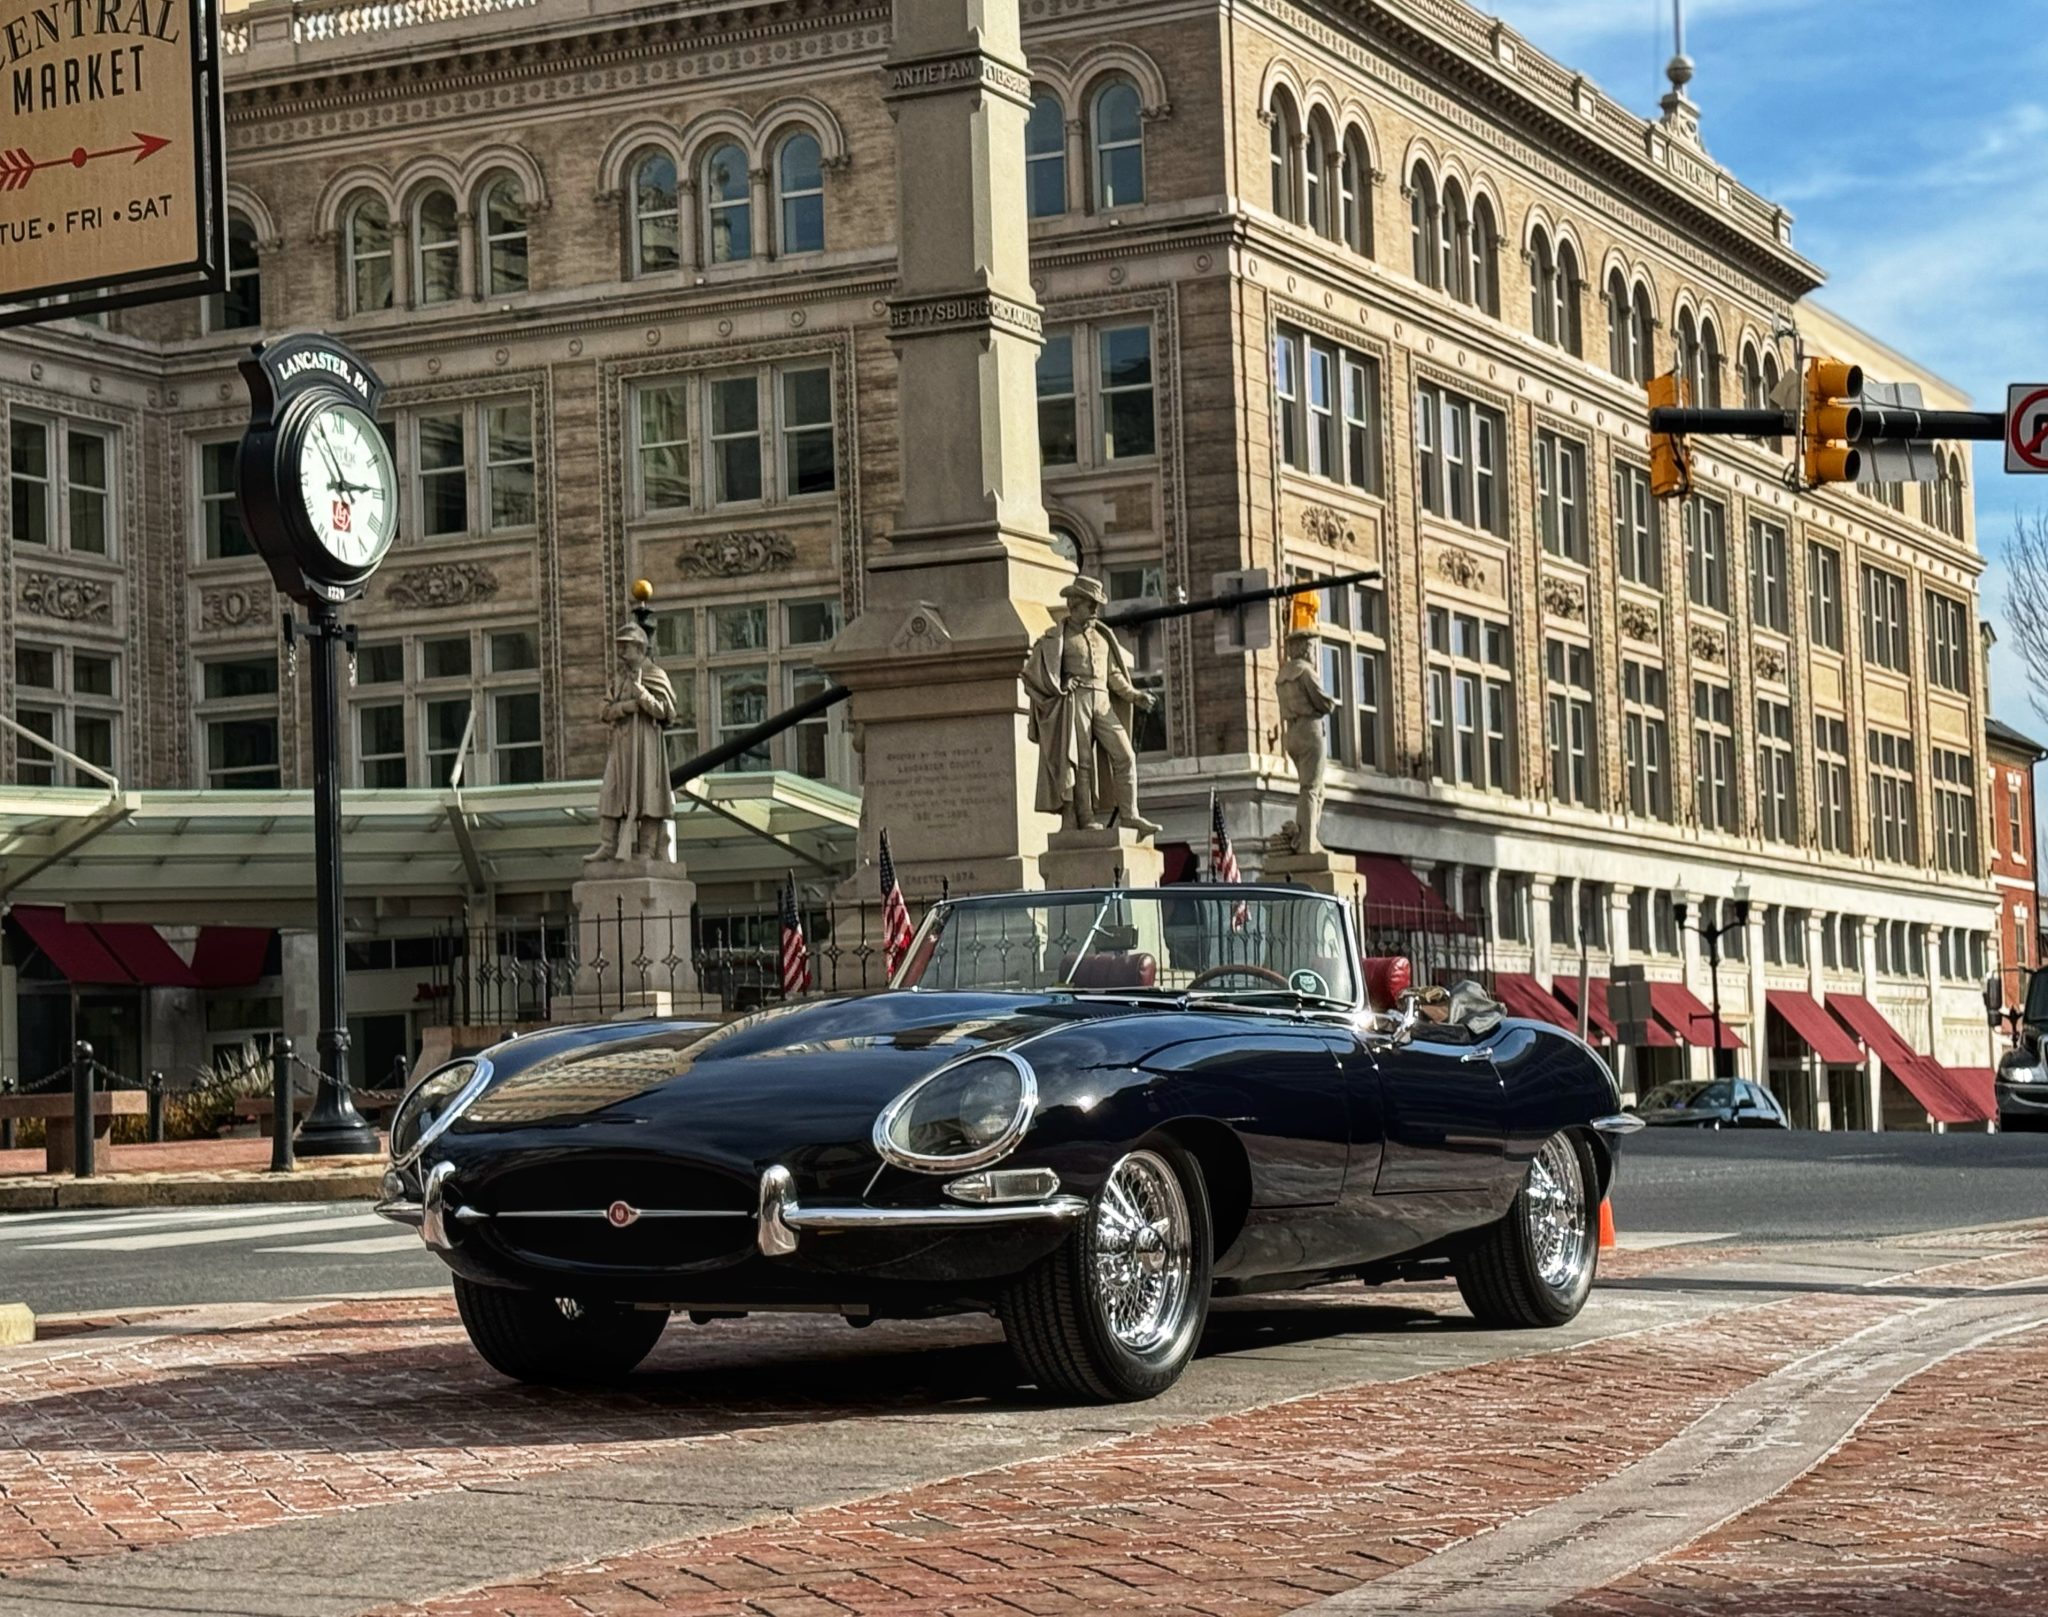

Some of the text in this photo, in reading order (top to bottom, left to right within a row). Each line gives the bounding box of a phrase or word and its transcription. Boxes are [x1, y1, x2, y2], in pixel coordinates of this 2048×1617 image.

[0, 0, 180, 70] ENTRAL
[13, 45, 144, 116] MARKET
[893, 60, 975, 89] ANTIETAM
[66, 207, 103, 233] FRI
[127, 194, 173, 222] SAT
[890, 300, 990, 328] GETTYSBURG
[277, 350, 368, 398] LANCASTER, PA
